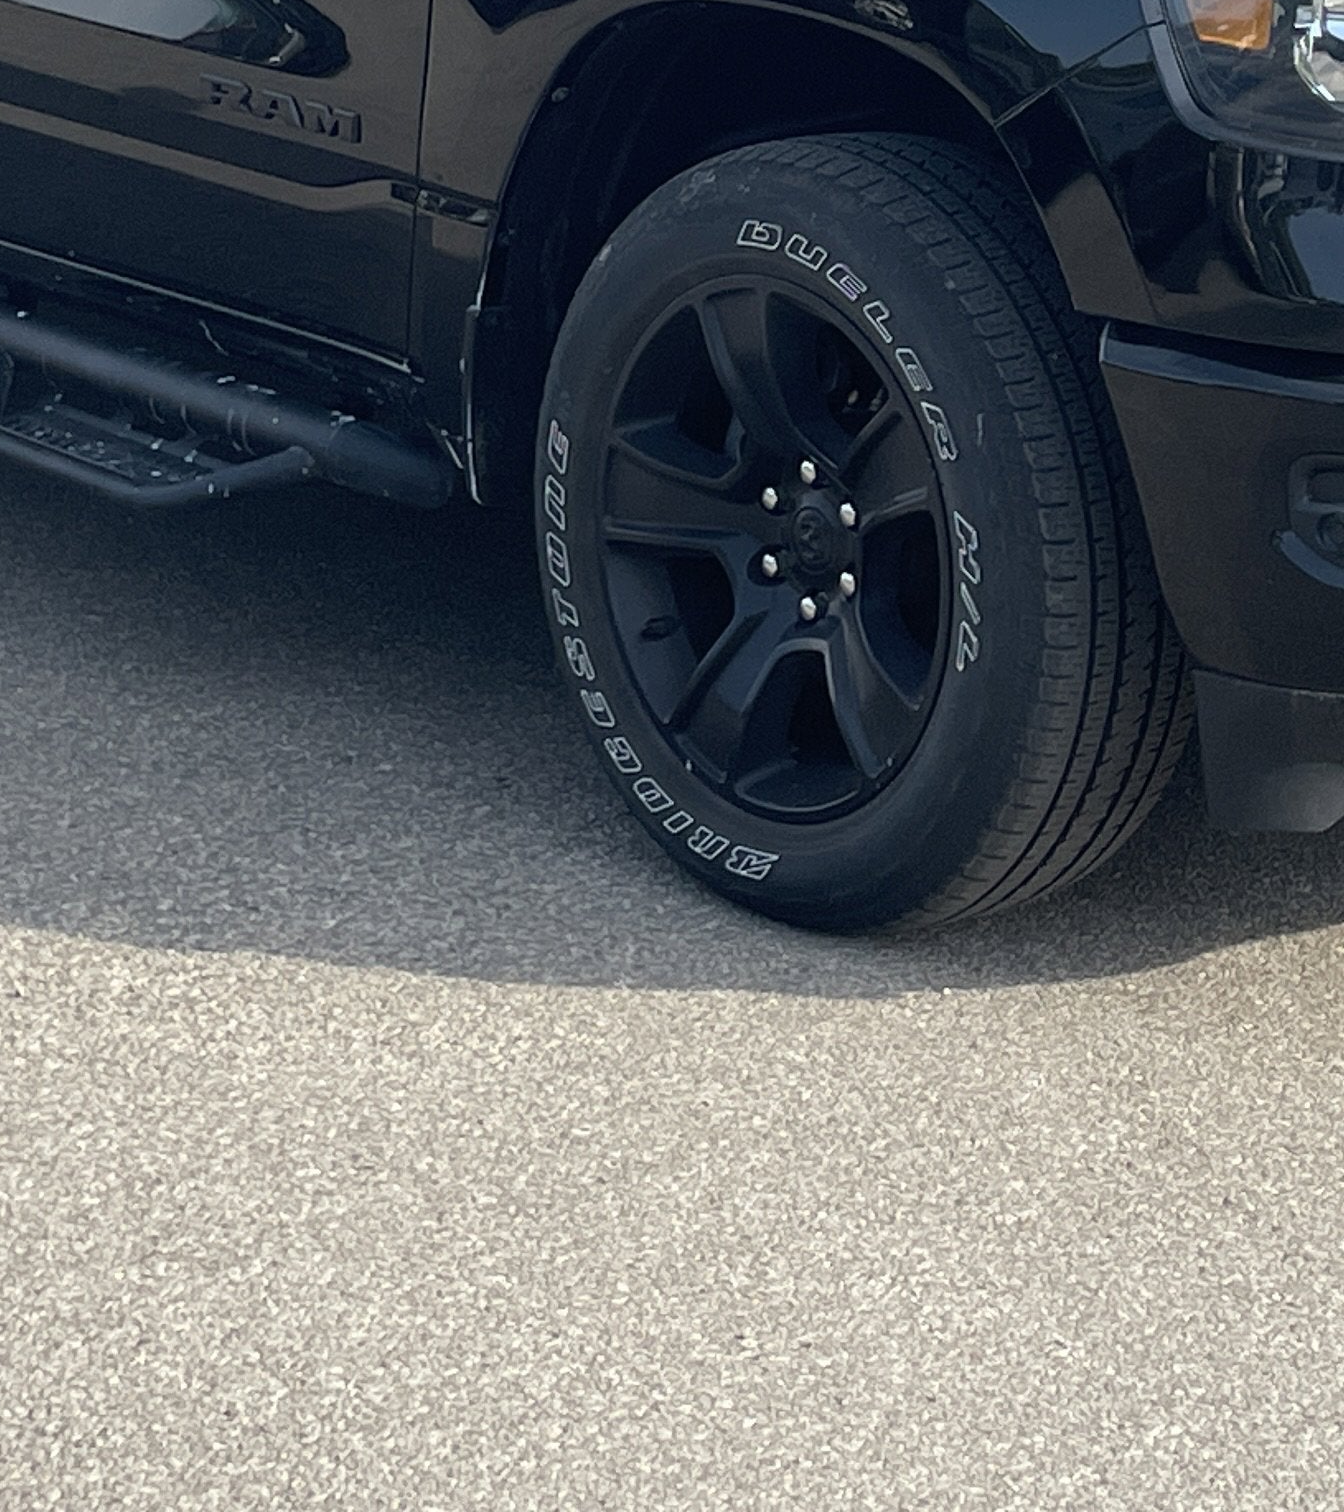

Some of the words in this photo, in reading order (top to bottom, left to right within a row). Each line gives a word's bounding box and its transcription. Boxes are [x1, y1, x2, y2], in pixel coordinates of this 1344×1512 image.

[199, 73, 363, 144] RAM
[735, 218, 960, 463] DUELER
[543, 419, 780, 881] BRIDGESTONE
